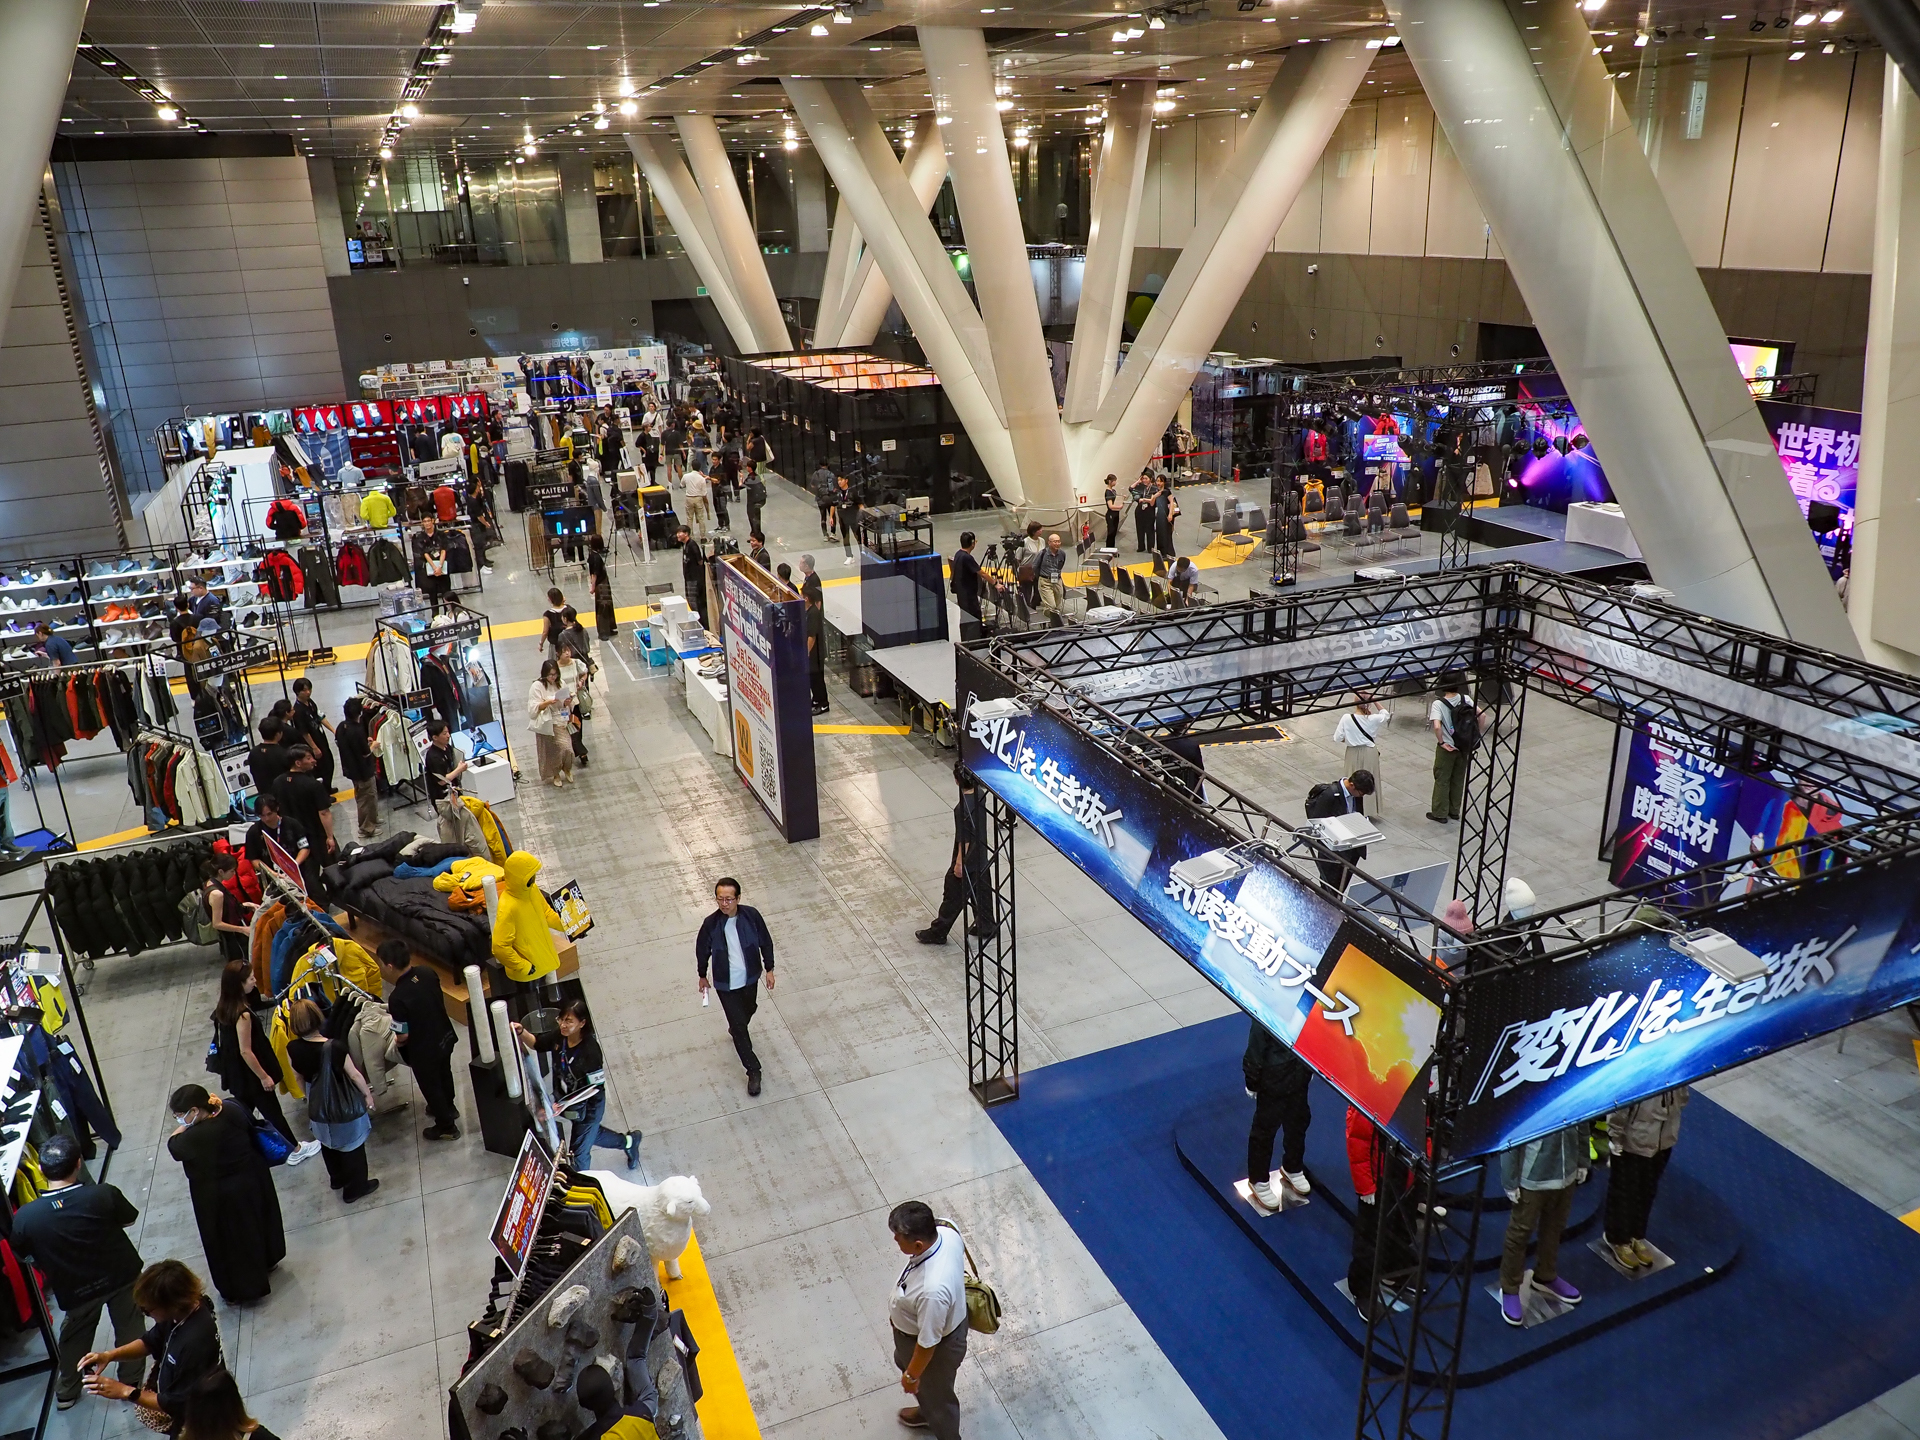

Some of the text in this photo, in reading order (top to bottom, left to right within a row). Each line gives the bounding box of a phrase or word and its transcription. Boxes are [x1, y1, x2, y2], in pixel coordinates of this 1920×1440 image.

[1777, 422, 1861, 469] 世界初
[541, 486, 569, 495] KAITEKI
[1654, 758, 1706, 807] 着る
[1632, 784, 1719, 853] 断熱材
[962, 691, 1360, 1036] 『変化』を生き抜く 気候変動ブース
[1468, 925, 1857, 1105] 『変化』を生き抜く
